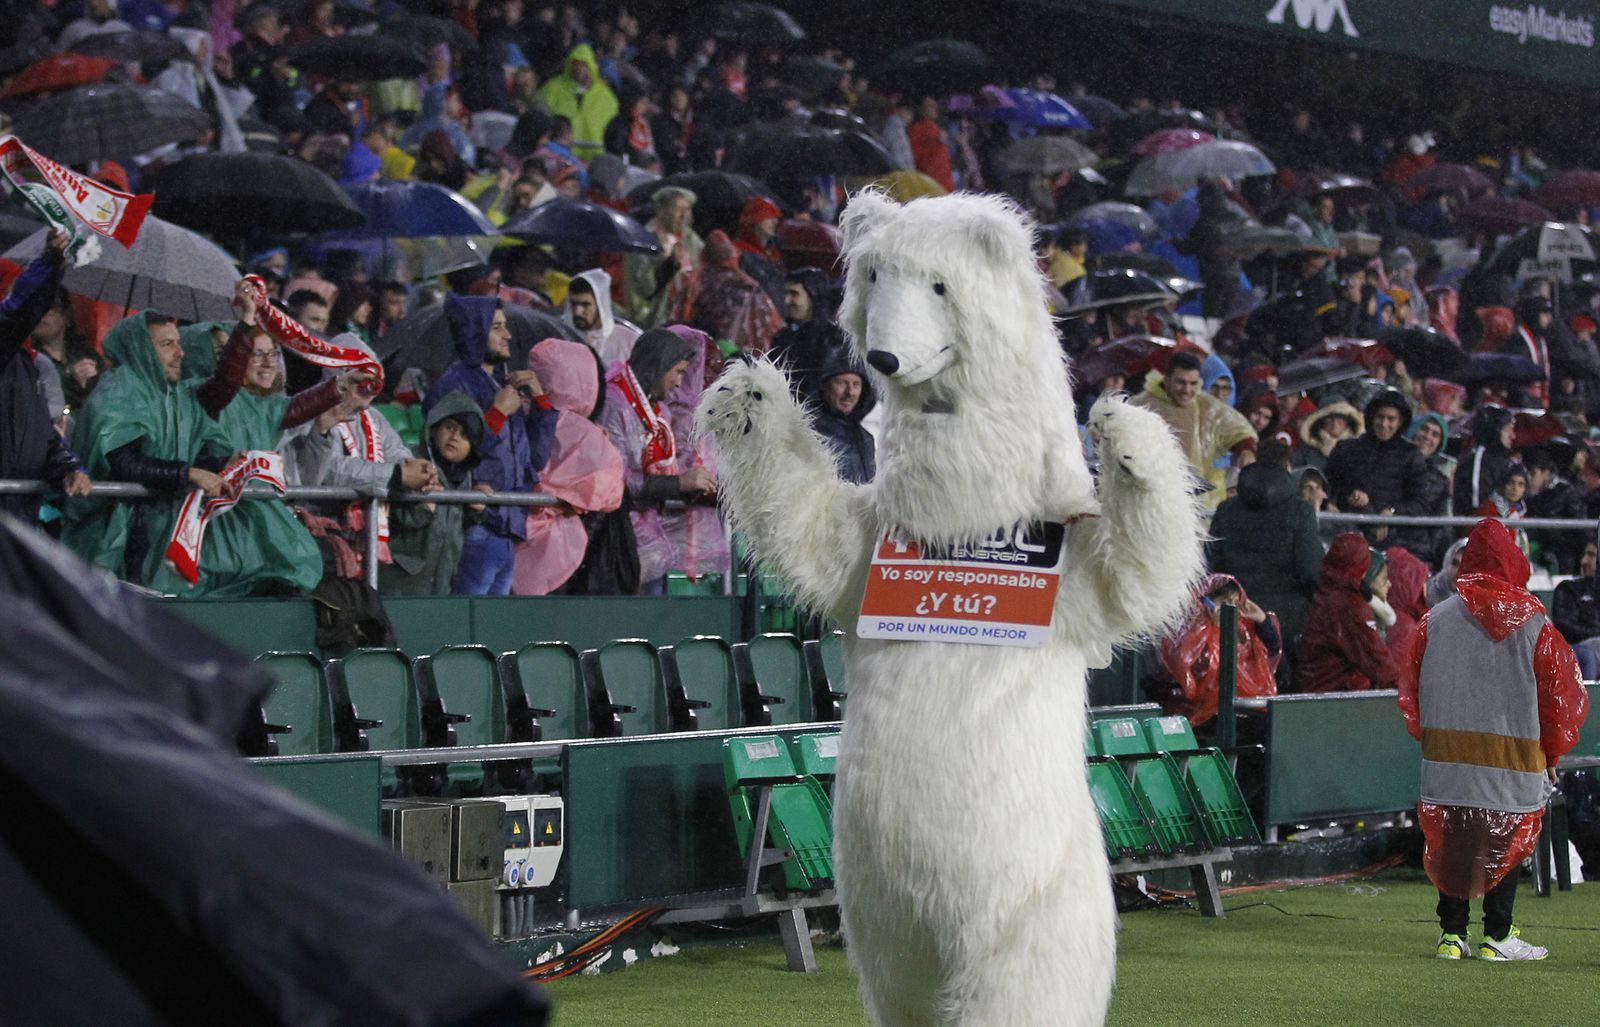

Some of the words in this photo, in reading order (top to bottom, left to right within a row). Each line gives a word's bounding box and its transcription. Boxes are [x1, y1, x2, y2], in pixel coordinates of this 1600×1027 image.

[1489, 4, 1595, 47] easyMarkets
[880, 567, 900, 581] Yo
[904, 569, 934, 584] soy
[937, 570, 1048, 589] responsable
[915, 592, 948, 614] ¿Y
[952, 593, 998, 615] tú?
[878, 622, 904, 633] POR
[907, 623, 926, 634] UN
[929, 624, 979, 637] MUNDO
[981, 628, 1027, 641] MEJOR
